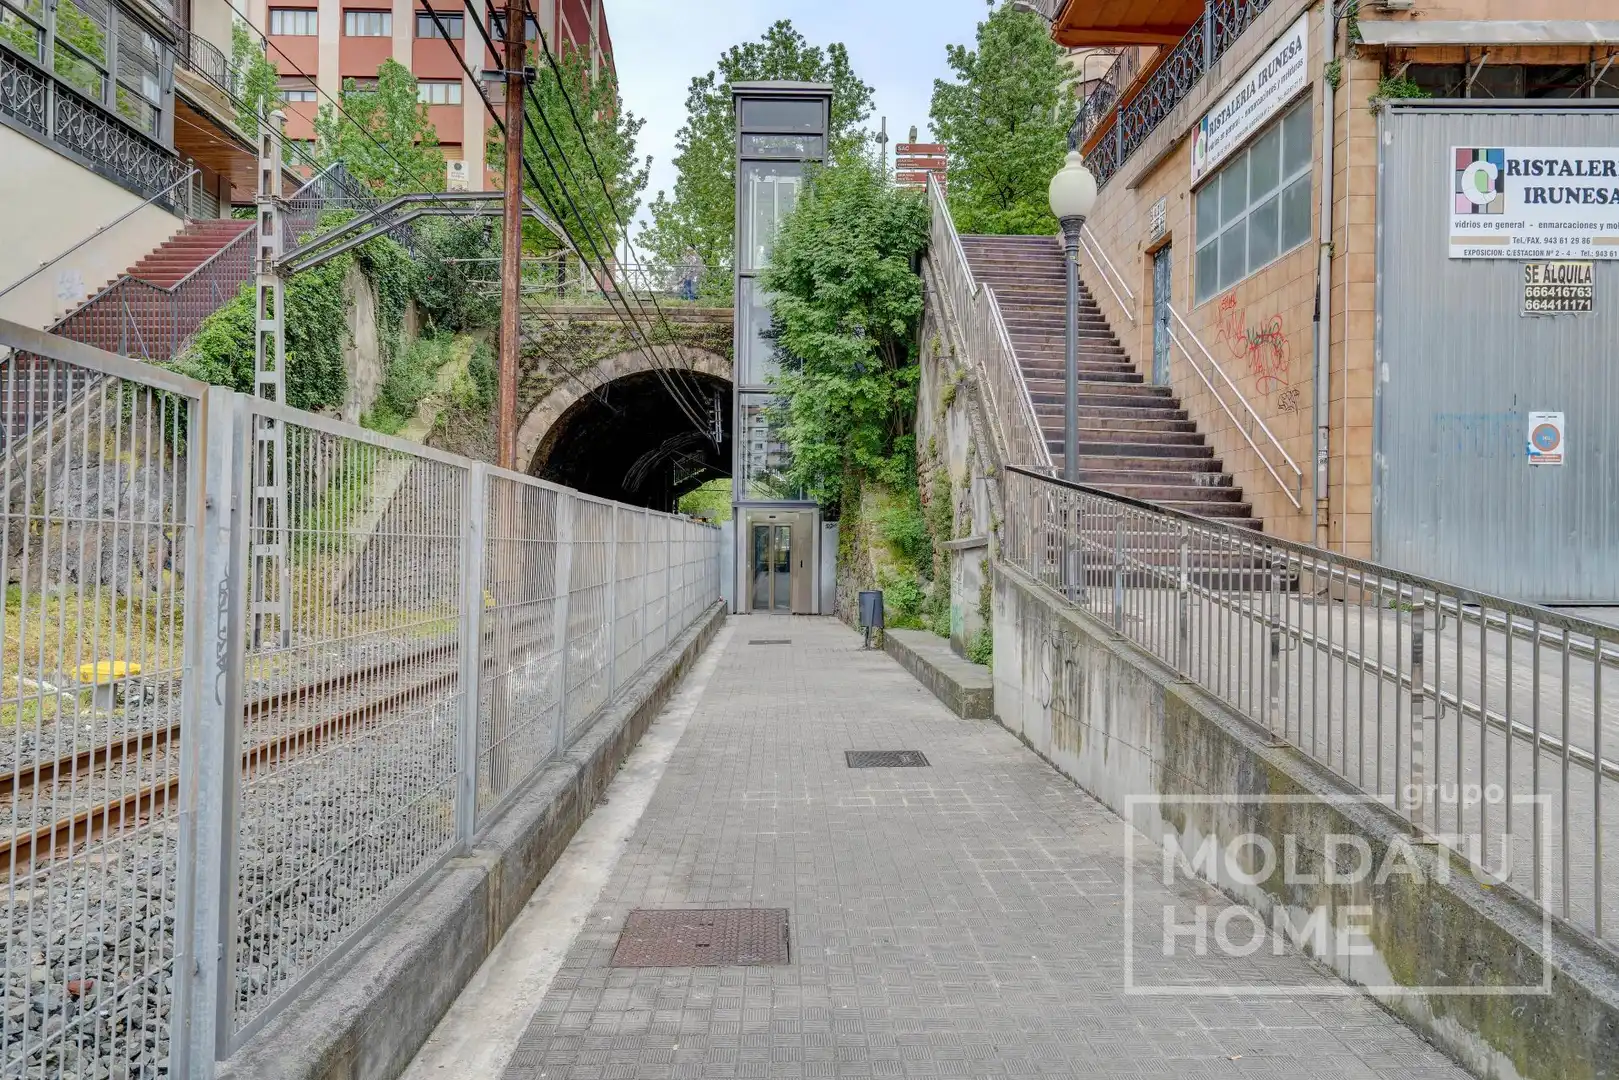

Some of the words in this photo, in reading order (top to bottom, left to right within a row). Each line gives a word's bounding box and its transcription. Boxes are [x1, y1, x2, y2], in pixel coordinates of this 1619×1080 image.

[1208, 79, 1256, 138] RISTALERIA
[1258, 34, 1303, 90] IRUNESA
[1506, 159, 1619, 177] RISTALER
[1523, 186, 1619, 205] IRUNESA
[1455, 220, 1481, 229] vidrios
[1483, 221, 1493, 229] en
[1495, 220, 1525, 231] general
[1538, 220, 1598, 230] enmarcaciones
[1599, 222, 1605, 231] y
[1543, 236, 1558, 245] 943
[1559, 236, 1568, 245] 61
[1570, 236, 1580, 245] 29
[1525, 264, 1539, 284] SE
[1543, 264, 1592, 284] ALQUILA
[1525, 286, 1592, 298] 666416763
[1525, 299, 1591, 310] 664411171
